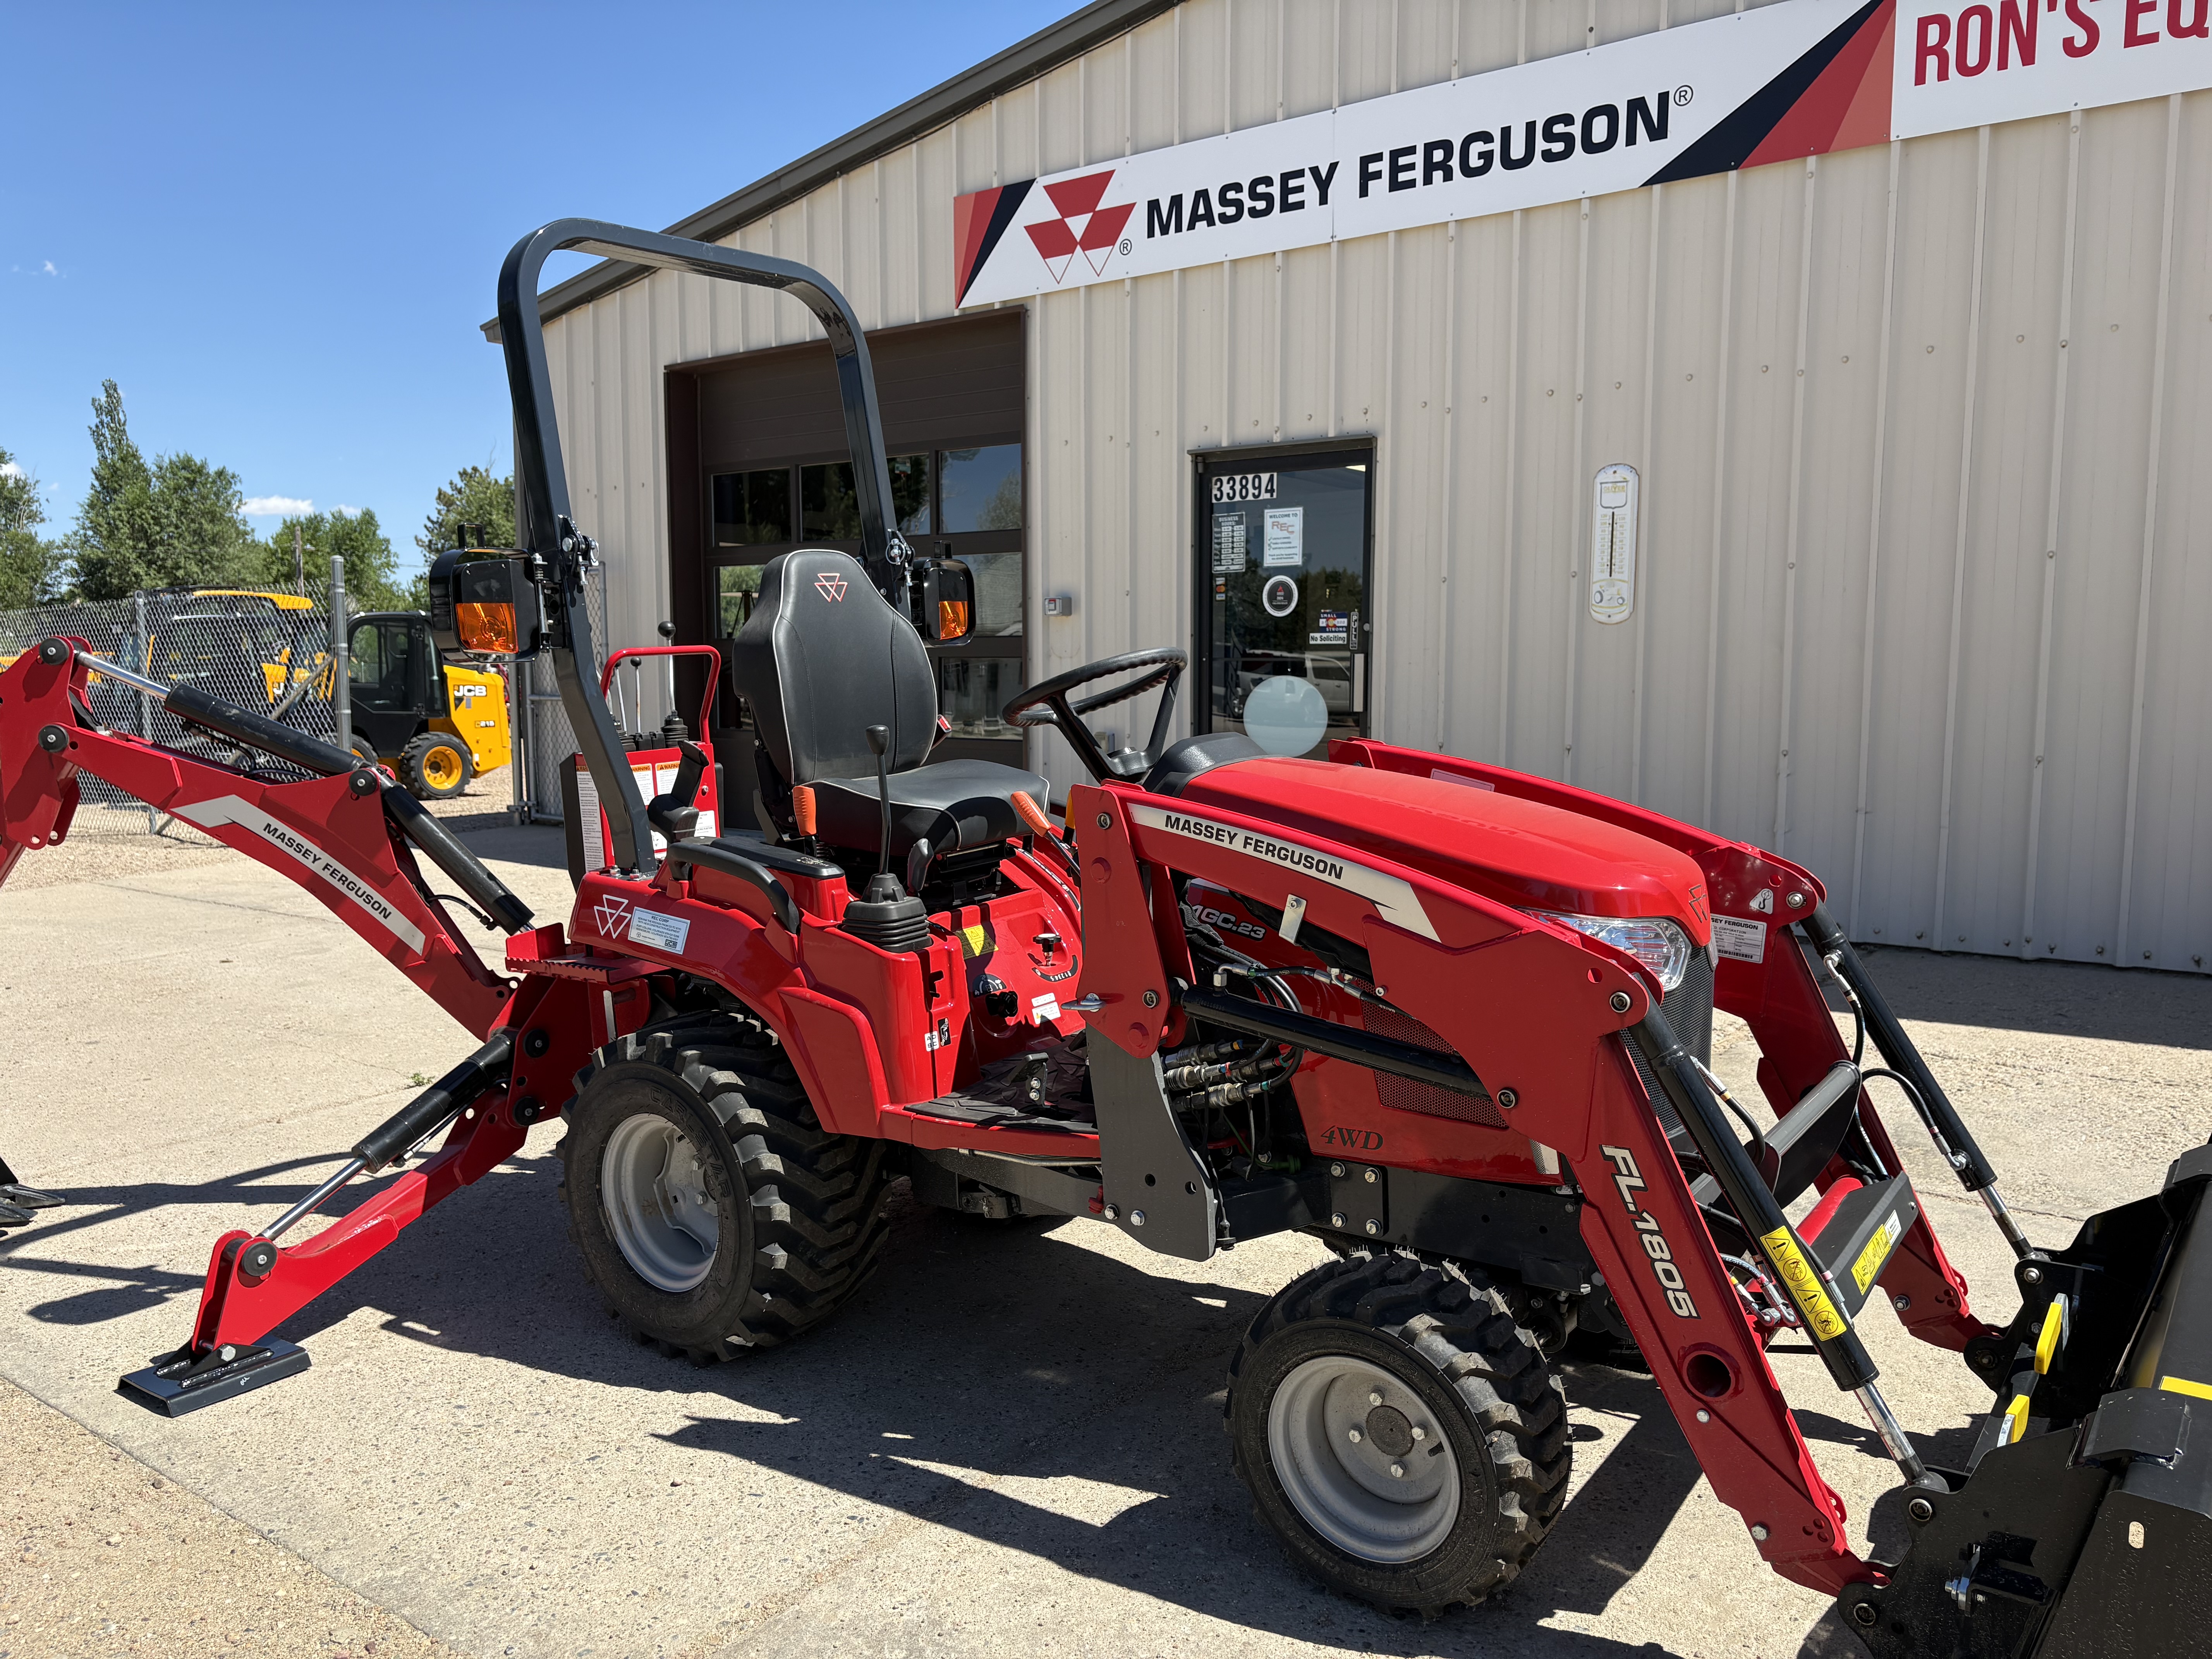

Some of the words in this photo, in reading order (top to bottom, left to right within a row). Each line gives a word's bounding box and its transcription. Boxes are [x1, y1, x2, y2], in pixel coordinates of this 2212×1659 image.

[1914, 0, 2100, 86] RON'S
[1146, 160, 1339, 239] MASSEY
[1358, 91, 1669, 198] FERGUSON
[1214, 474, 1275, 502] 33894
[1271, 521, 1295, 534] REC
[1319, 635, 1346, 643] Soliciting
[454, 685, 486, 696] JCB
[1164, 815, 1238, 845] MASSEY
[1243, 835, 1344, 880] FERGUSON
[263, 822, 321, 865] MASSEY
[322, 862, 392, 919] FERGUSON
[1724, 920, 1758, 930] FERGUSON
[1320, 1125, 1383, 1151] 4WD
[1601, 1146, 1699, 1318] FL.1805
